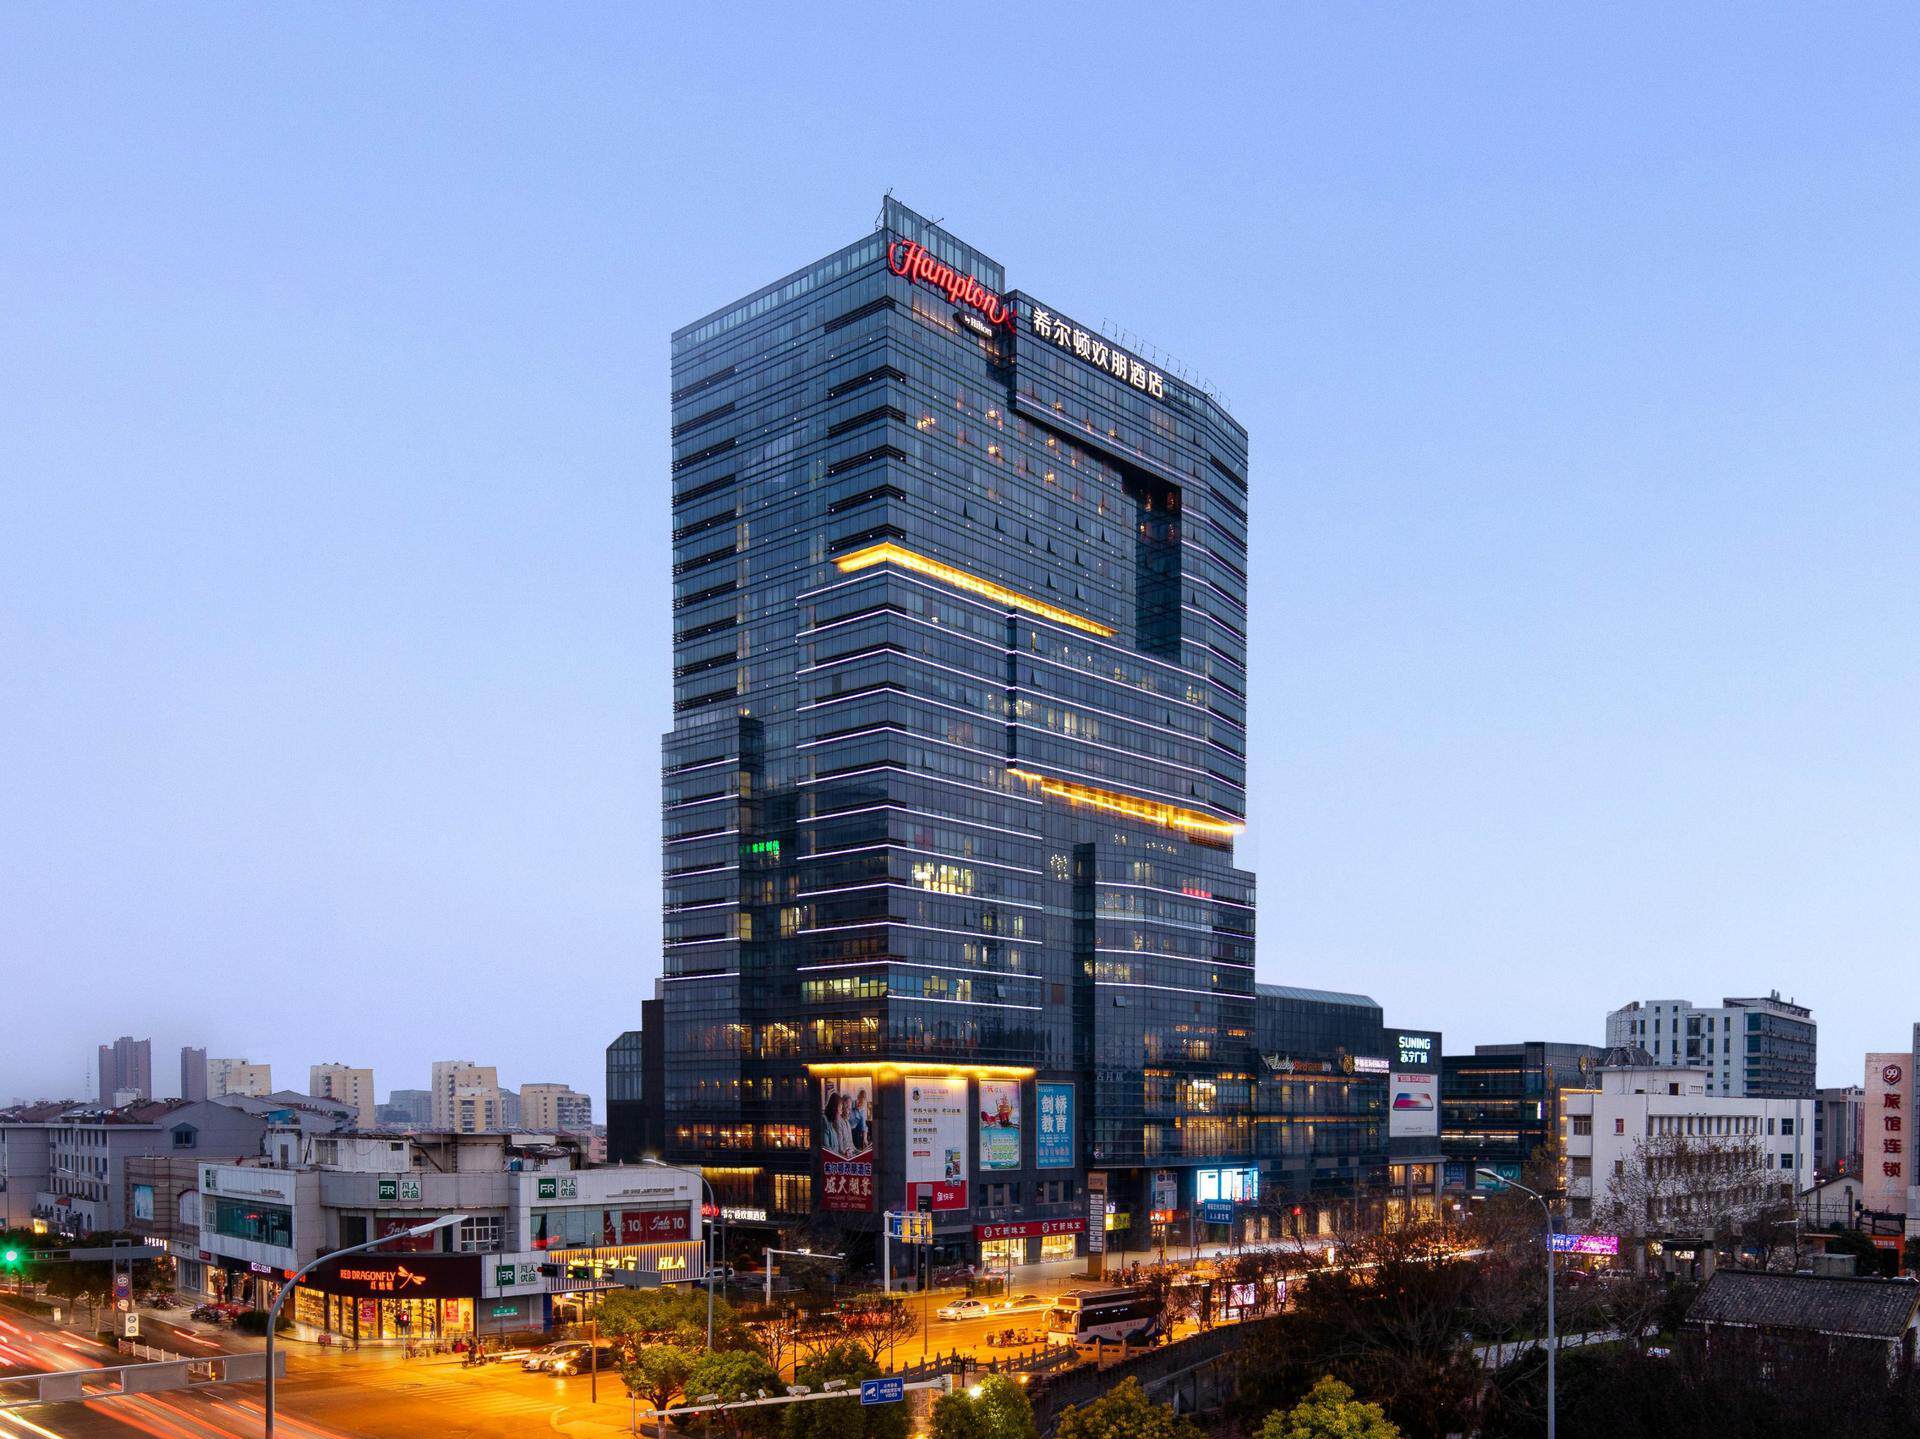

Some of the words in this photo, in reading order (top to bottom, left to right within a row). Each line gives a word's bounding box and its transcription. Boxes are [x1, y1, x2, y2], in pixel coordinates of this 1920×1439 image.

[888, 239, 1009, 325] Hampton
[971, 318, 993, 337] Hilton
[1032, 306, 1164, 398] 希尔顿欢朋酒店
[1398, 1036, 1431, 1050] SUNING
[1886, 1069, 1898, 1079] 99
[1041, 1114, 1068, 1133] 教育
[1883, 1093, 1902, 1178] 旅馆连锁
[628, 1219, 640, 1232] 10
[673, 1217, 685, 1230] 10
[657, 1255, 686, 1270] HLA
[340, 1269, 351, 1279] RED
[351, 1270, 396, 1281] DRAGONFLY
